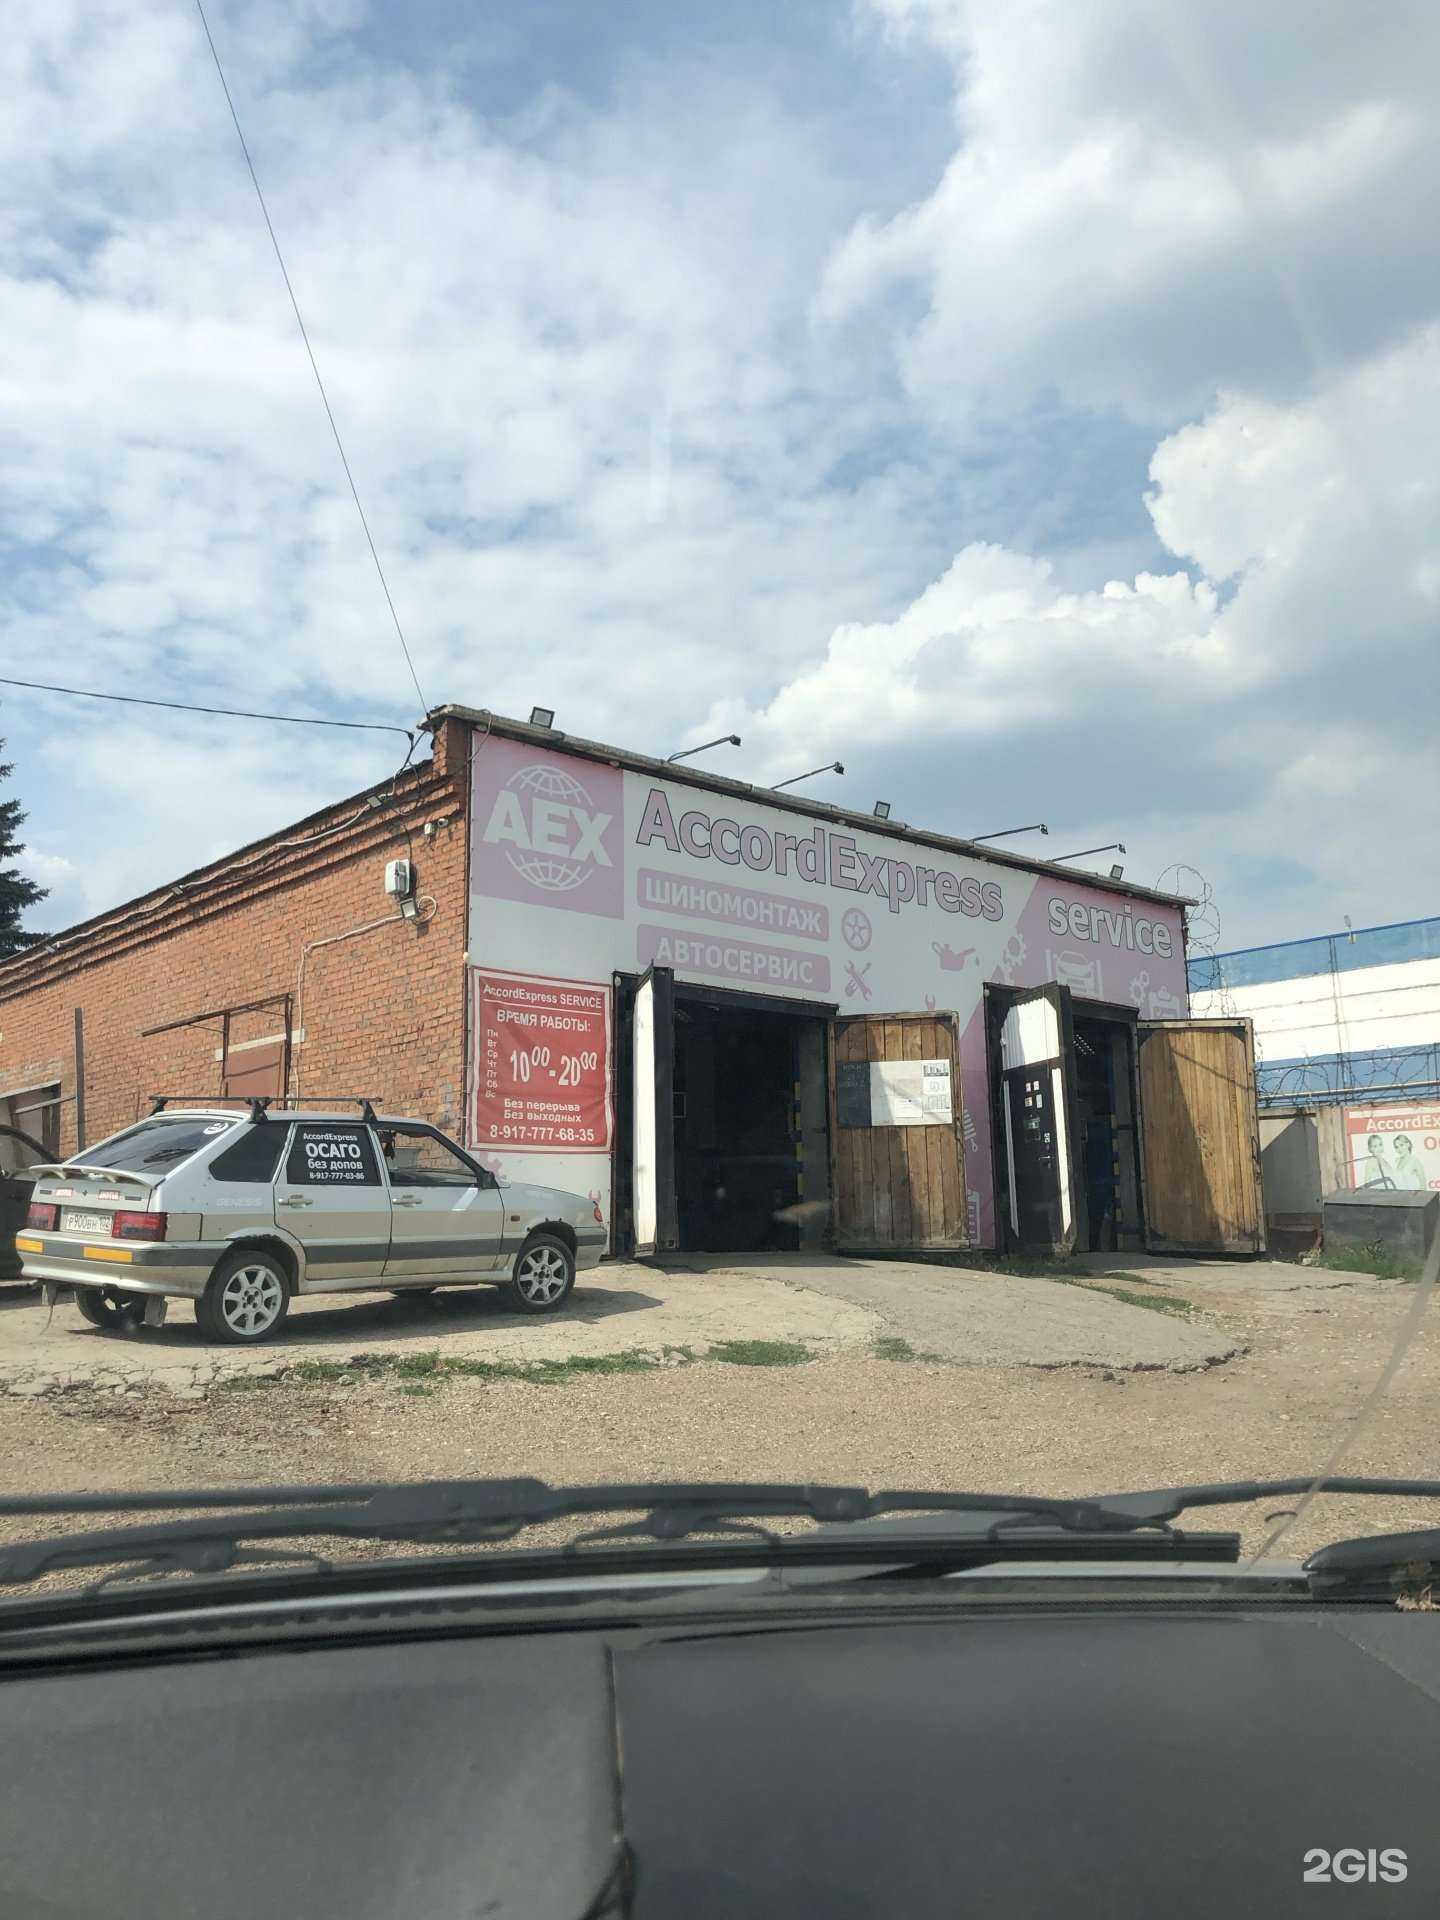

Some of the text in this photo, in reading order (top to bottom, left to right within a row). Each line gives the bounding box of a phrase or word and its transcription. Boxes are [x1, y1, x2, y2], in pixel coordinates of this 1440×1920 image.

[482, 790, 613, 867] AEX
[636, 788, 1173, 958] AccordExpress service
[645, 877, 823, 934] ШИНОМОНТАЖ
[656, 937, 814, 984] АВТОСЕРВИС
[483, 985, 602, 1009] AccordExpress SERVICE
[497, 1009, 591, 1032] ВРЕМЯ РАБОТЫ:
[504, 1099, 580, 1112] Без перерыва
[504, 1109, 582, 1123] Без выходных
[490, 1124, 595, 1142] 8-917-777-68-35
[305, 1142, 361, 1159] ОСАГО
[307, 1159, 363, 1171] без допов
